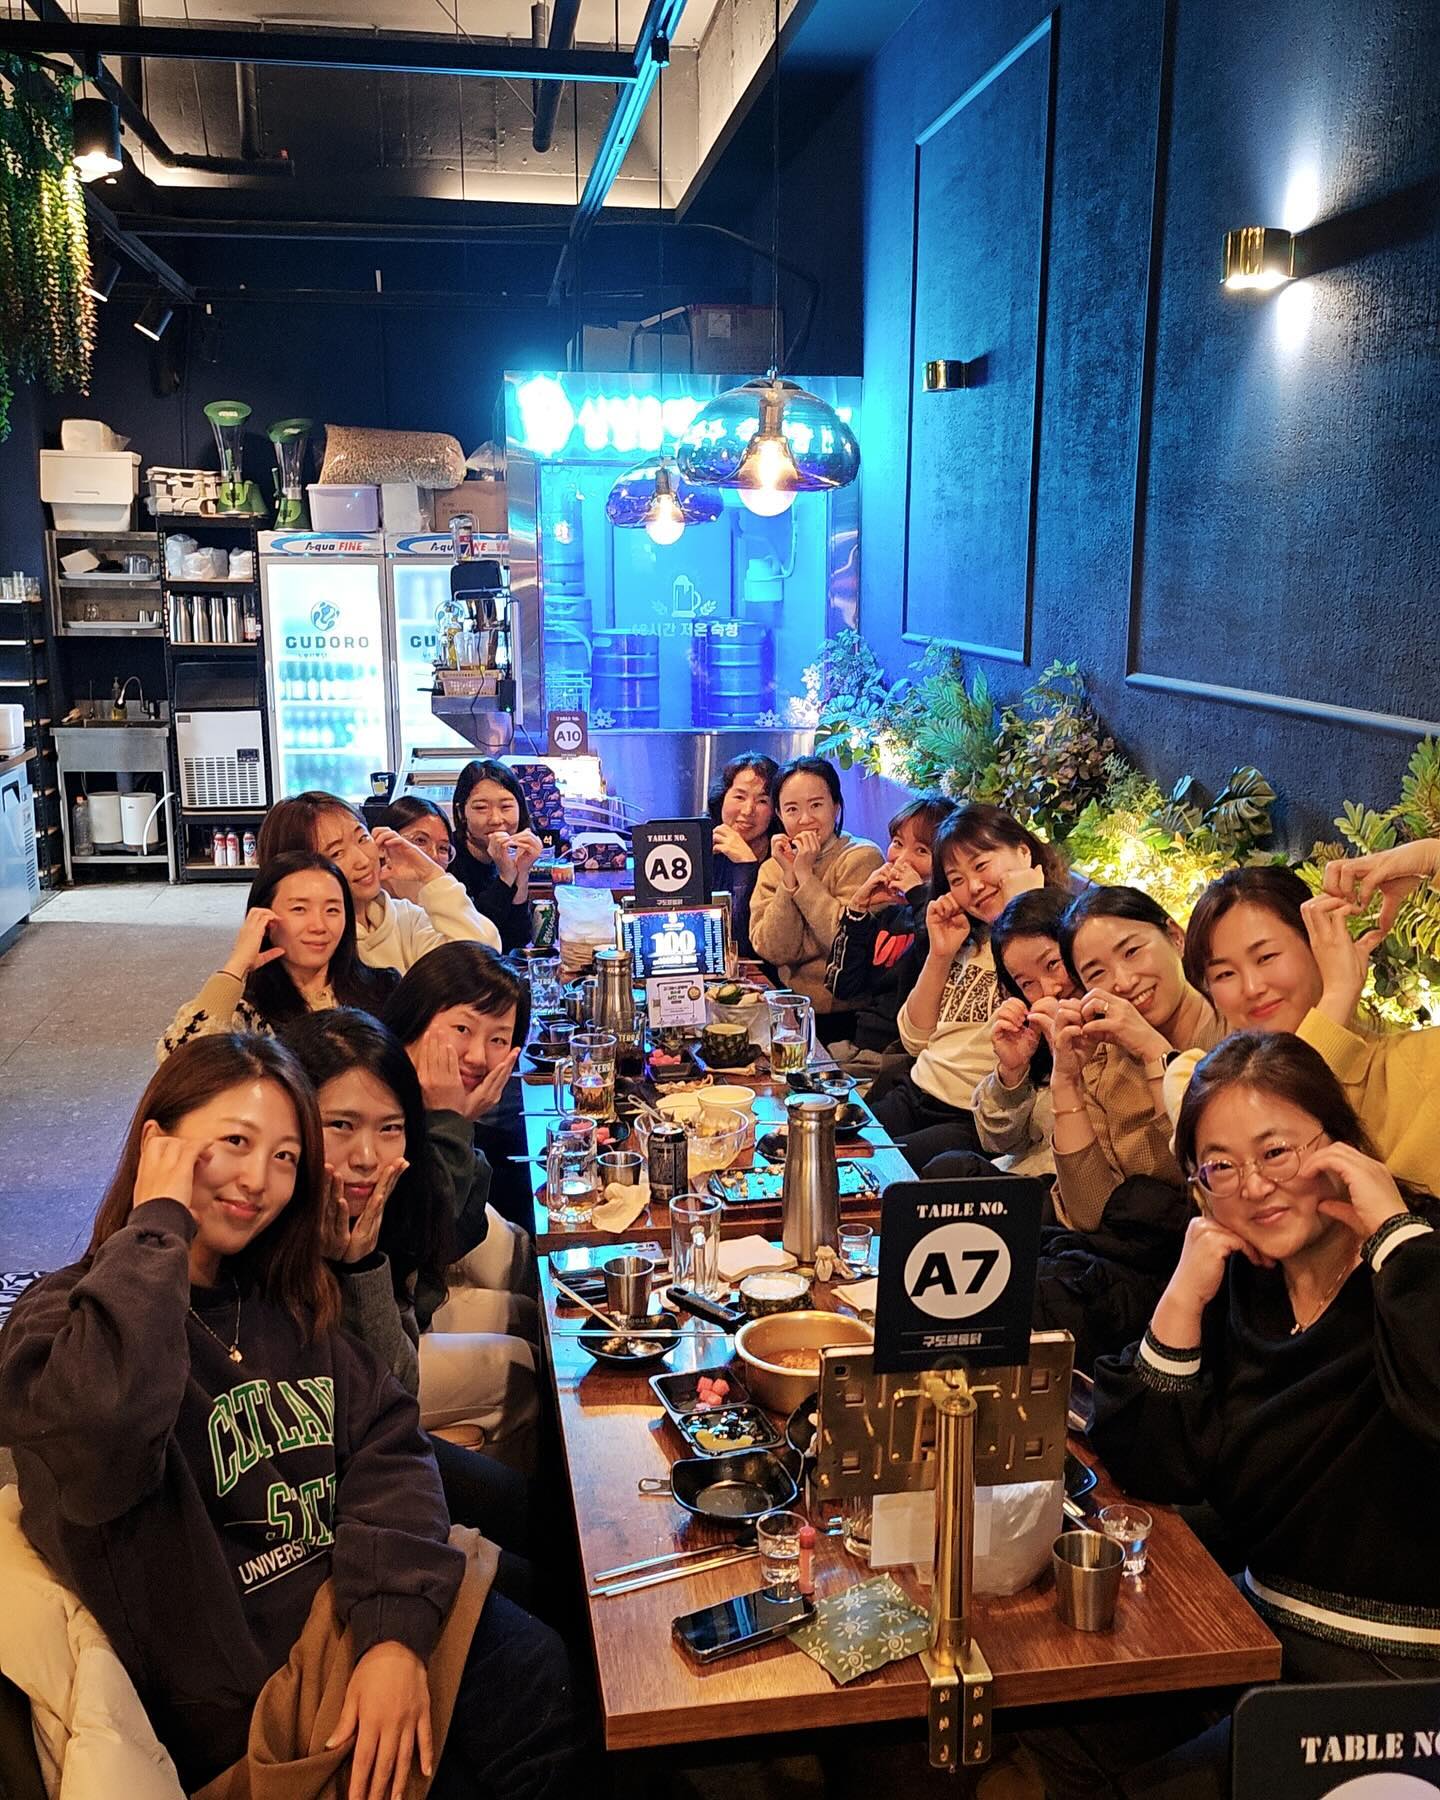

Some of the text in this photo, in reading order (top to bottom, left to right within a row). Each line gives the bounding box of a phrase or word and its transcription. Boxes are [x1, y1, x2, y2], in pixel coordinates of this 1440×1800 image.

[305, 542, 335, 552] Aqua
[338, 542, 363, 551] FINE
[711, 620, 738, 637] 숙성
[285, 636, 369, 649] GUDORO
[555, 730, 581, 742] A10
[647, 834, 688, 843] TABLE NO.
[650, 857, 688, 881] A8
[650, 929, 697, 956] 100
[916, 1201, 1008, 1219] TABLE NO.
[910, 1250, 1000, 1297] A7
[1300, 1731, 1440, 1764] TABLE N
